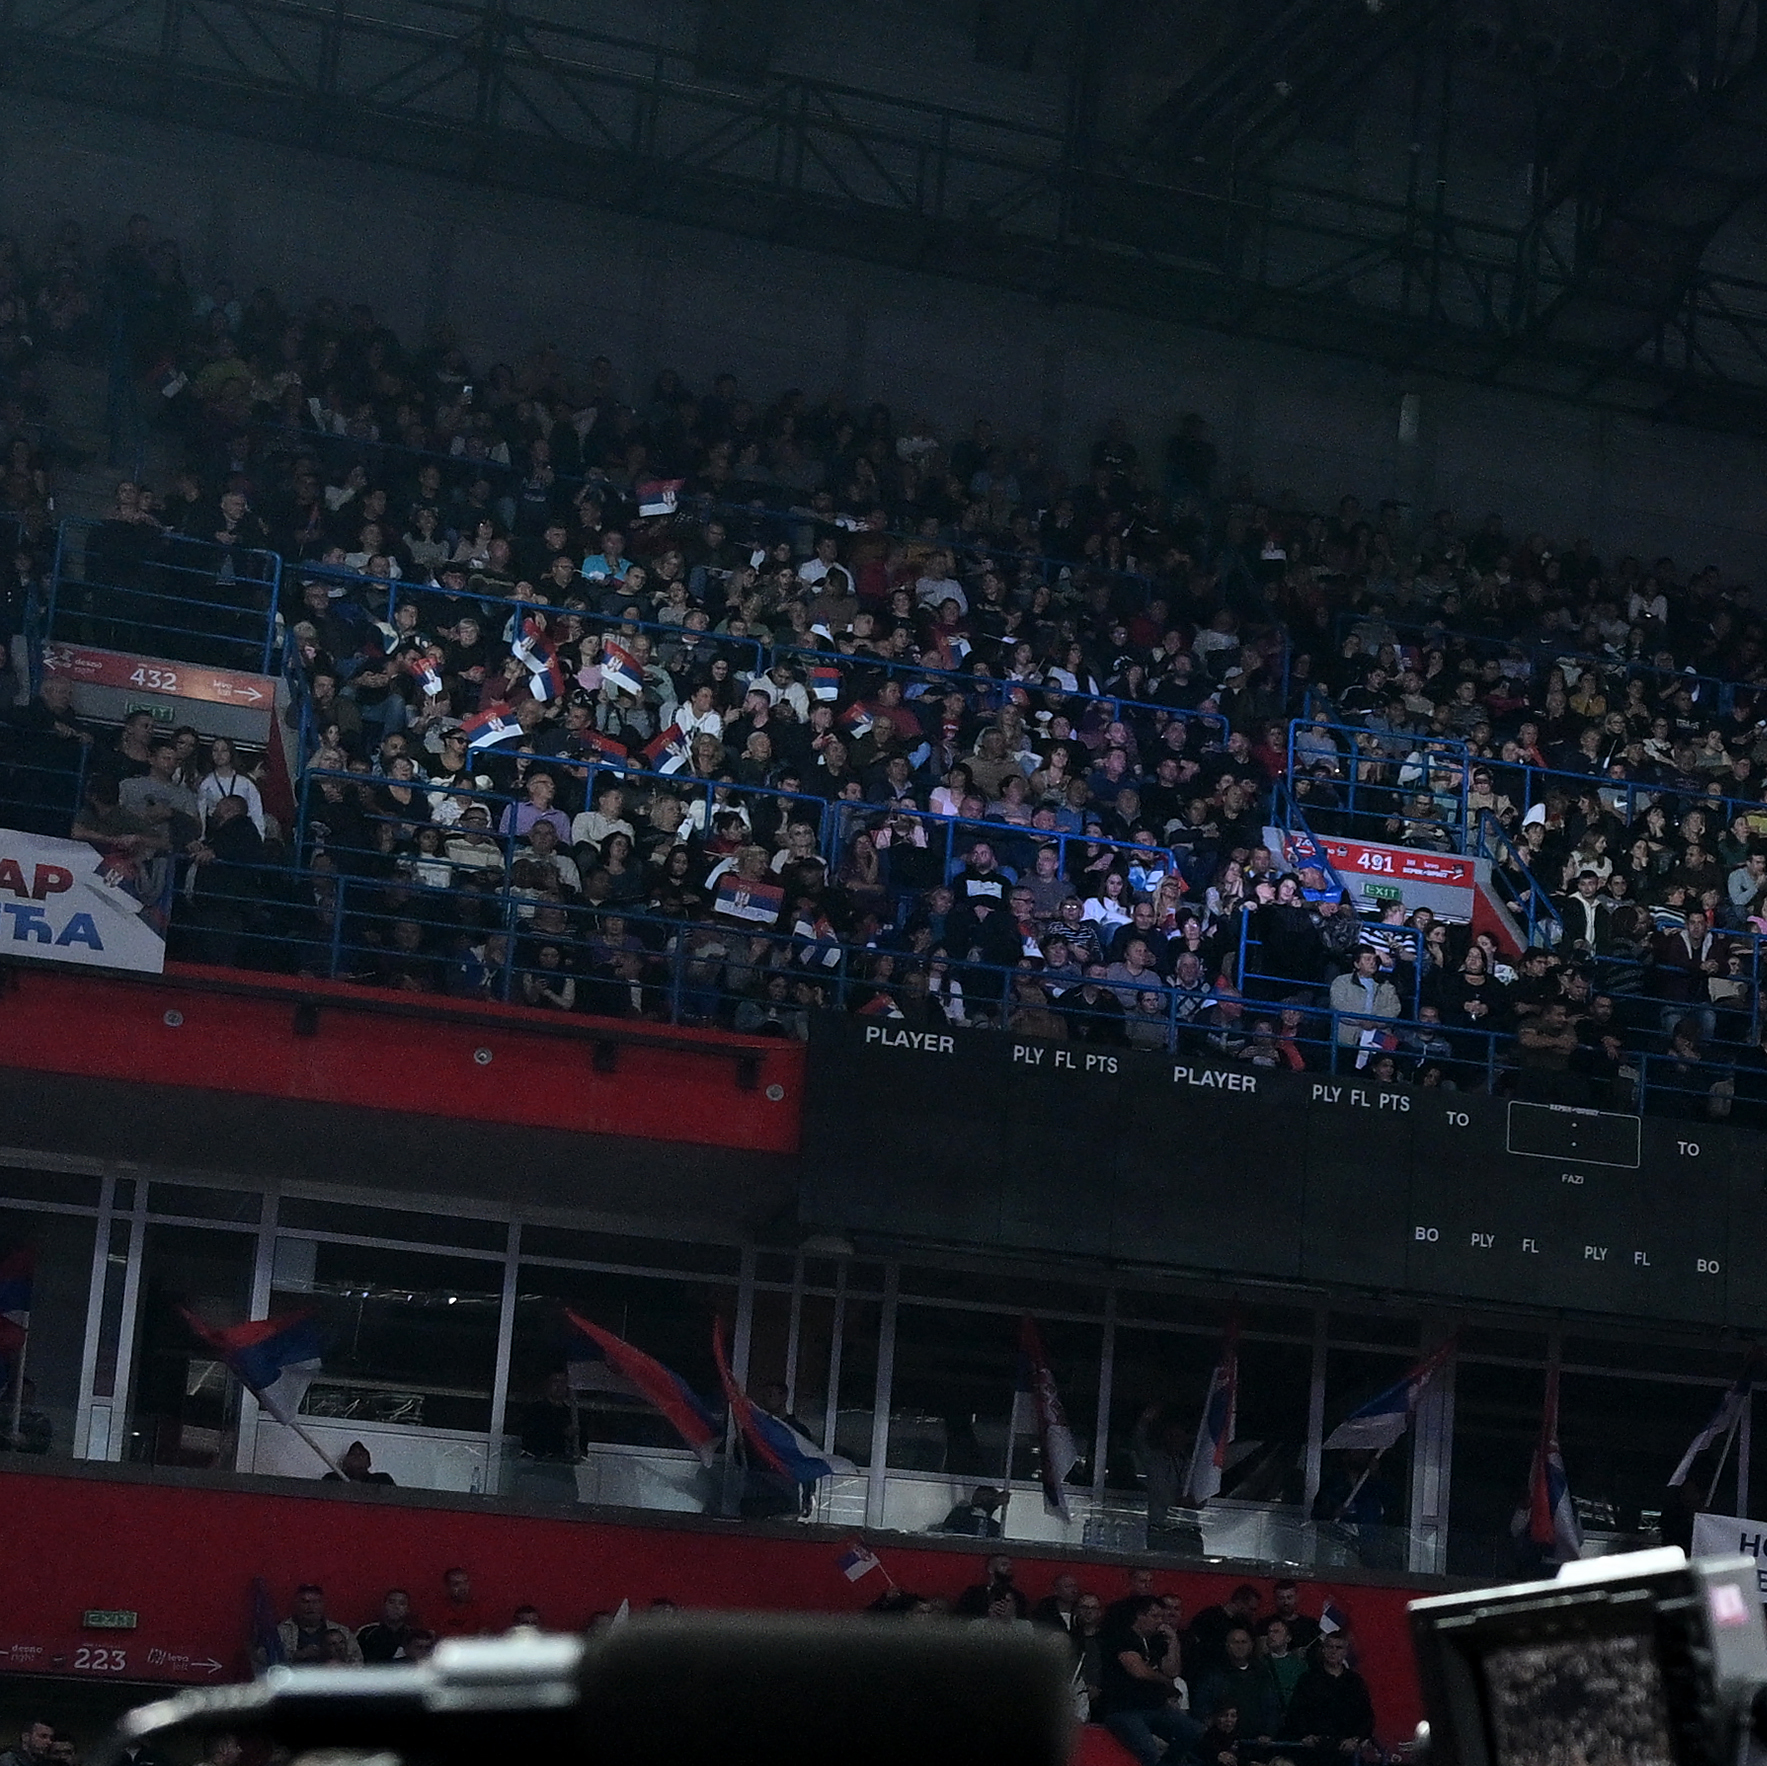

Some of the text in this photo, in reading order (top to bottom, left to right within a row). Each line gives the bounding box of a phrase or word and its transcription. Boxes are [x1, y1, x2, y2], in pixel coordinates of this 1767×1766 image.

[129, 667, 177, 691] 432
[1365, 884, 1398, 898] EXIT
[865, 1026, 1118, 1074] PLAYER PLY FL PTS
[1173, 1066, 1470, 1127] PLAYER PLY FL PTS TO
[1677, 1141, 1700, 1157] TO
[1414, 1226, 1720, 1275] BO PLY FL PLY FL BO
[73, 1647, 127, 1672] 223
